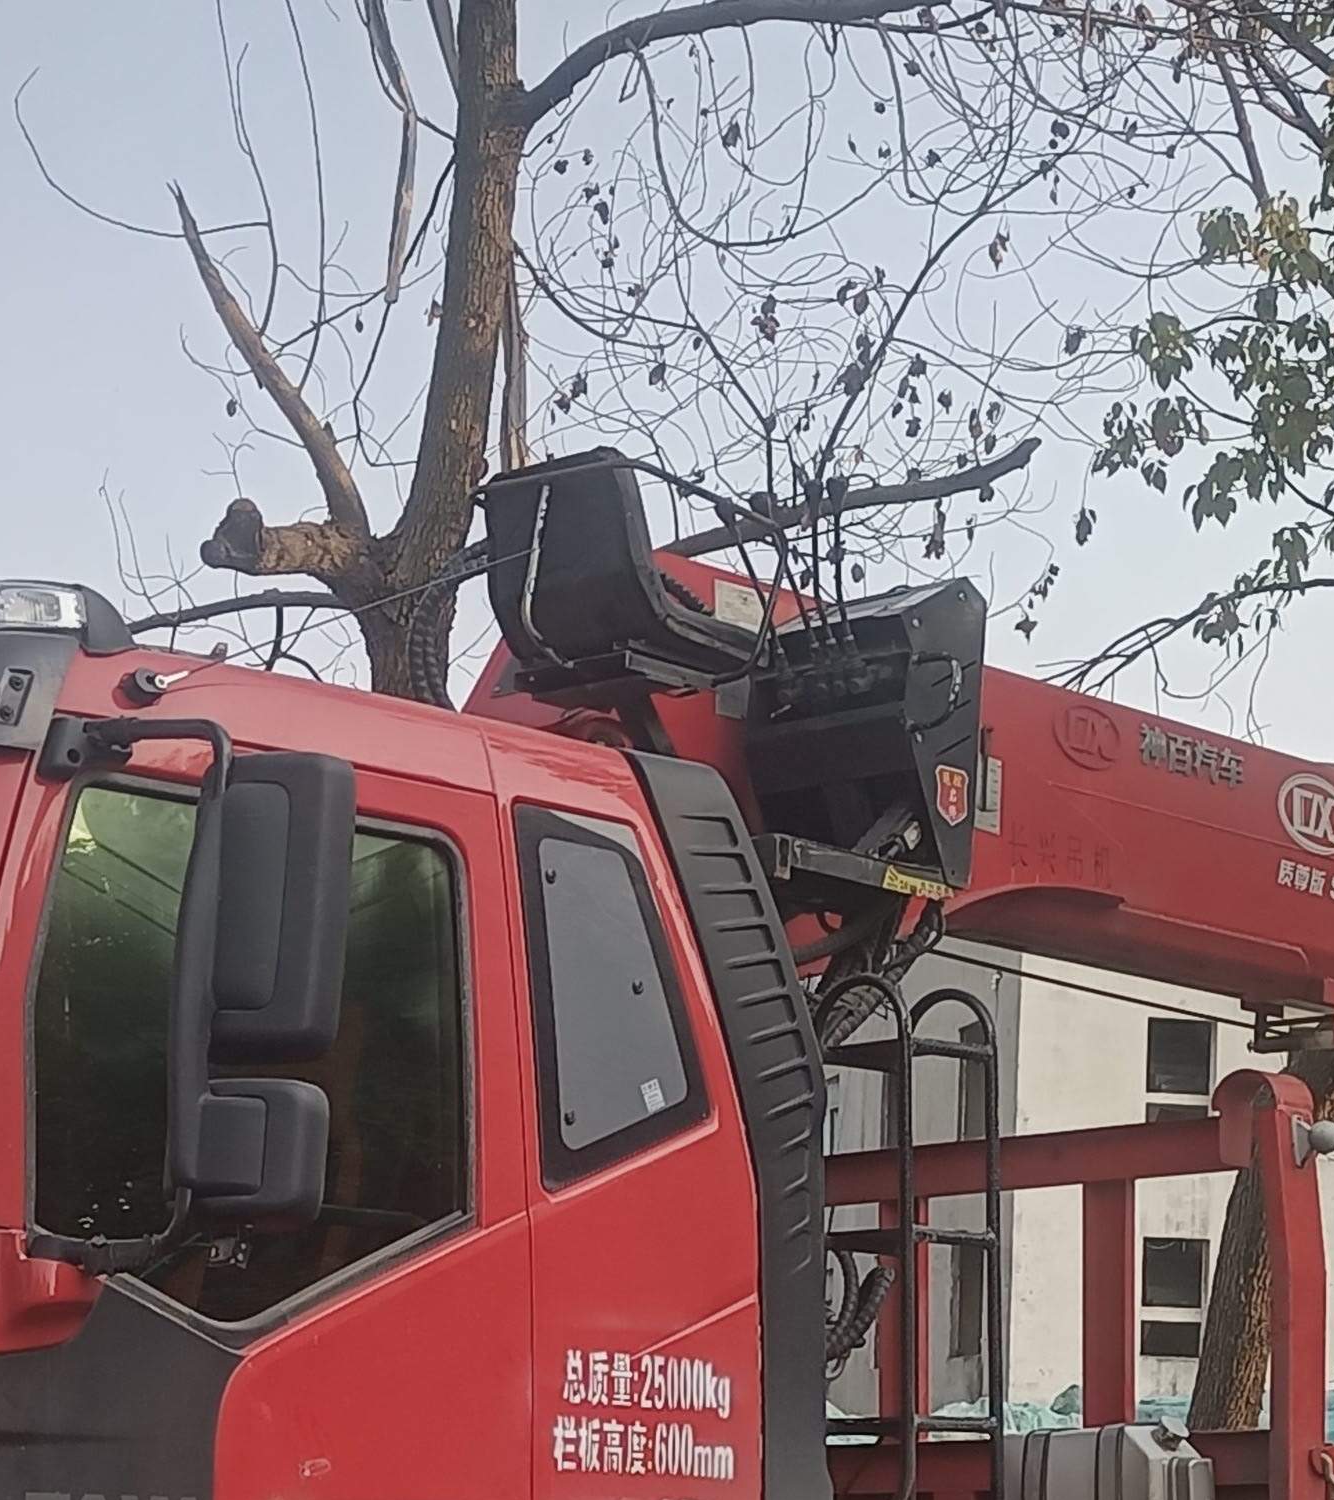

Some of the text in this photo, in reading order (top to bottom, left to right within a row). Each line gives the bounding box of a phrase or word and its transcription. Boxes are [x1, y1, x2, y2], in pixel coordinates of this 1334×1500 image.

[1139, 723, 1244, 788] 神百汽车
[563, 1349, 730, 1419] 总质量:25000kg
[553, 1414, 735, 1480] 栏板高度:600mm
